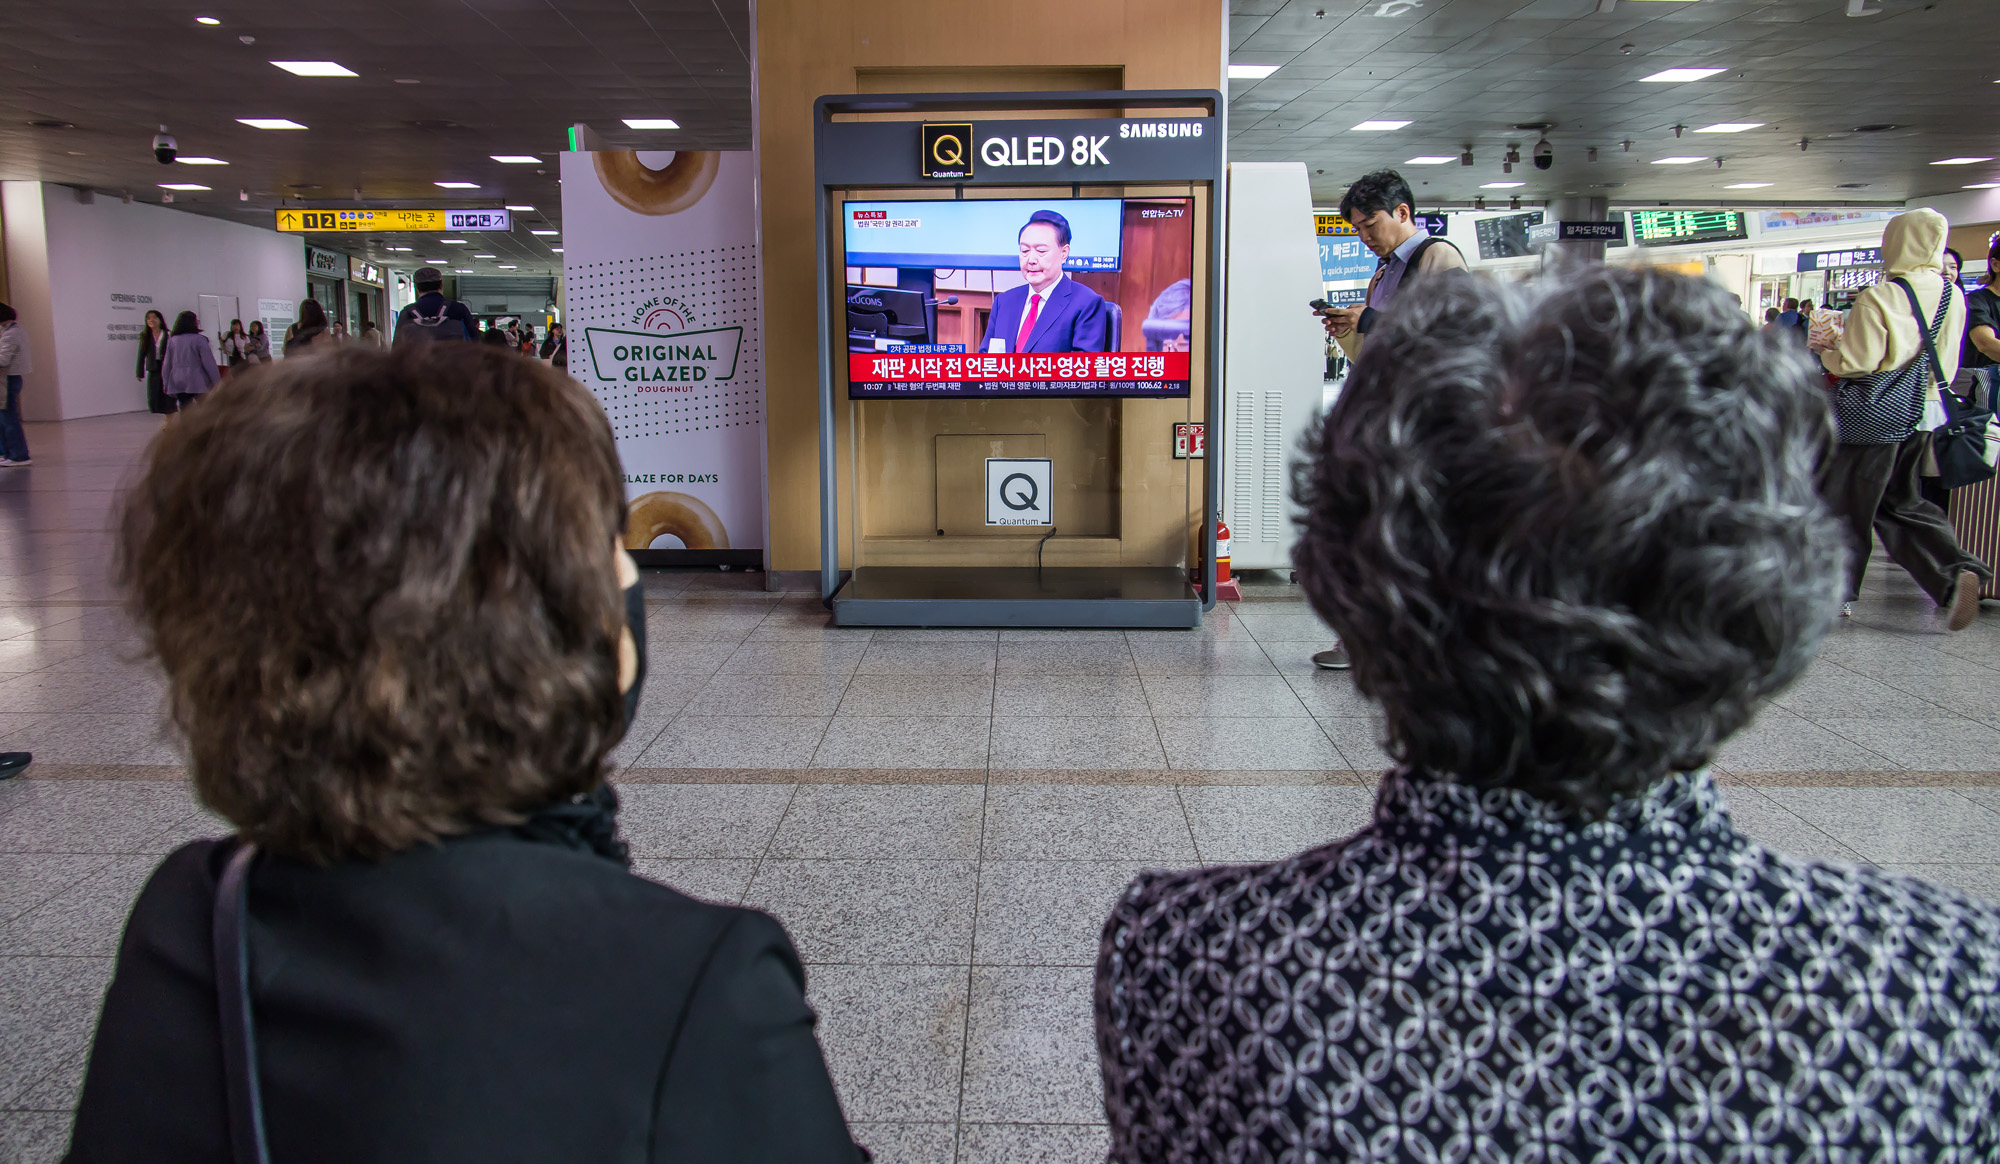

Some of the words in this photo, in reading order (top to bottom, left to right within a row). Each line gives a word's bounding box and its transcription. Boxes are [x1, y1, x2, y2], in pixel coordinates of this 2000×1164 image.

[1120, 123, 1203, 138] SAMSUNG
[981, 136, 1065, 167] QLED
[1071, 135, 1111, 165] 8K
[398, 212, 423, 222] 나가는
[427, 212, 435, 222] 곳
[1141, 209, 1184, 218] 연합뉴스TV
[324, 215, 333, 227] 2
[857, 220, 870, 228] 법원
[1566, 225, 1616, 235] 열차도착안내
[1332, 241, 1360, 261] 빠르고
[1327, 266, 1344, 277] quick
[111, 293, 136, 303] OPENING
[136, 295, 153, 303] SOON
[851, 296, 883, 306] LUCOMS
[631, 297, 660, 325] HOME
[663, 296, 679, 307] OF
[678, 302, 697, 324] THE
[613, 345, 718, 361] ORIGINAL
[890, 345, 902, 353] 2차
[903, 345, 917, 353] 공판
[917, 345, 932, 353] 법정
[933, 345, 947, 353] 내부
[948, 345, 963, 353] 공개
[872, 357, 906, 378] 재판
[908, 357, 942, 378] 시작
[945, 357, 962, 378] 전
[965, 357, 1015, 378] 언론사
[1018, 356, 1091, 378] 사진·영상
[1093, 356, 1127, 378] 촬영
[1131, 355, 1165, 378] 진행
[624, 366, 707, 382] GLAZED
[863, 383, 883, 391] 10:07
[947, 382, 962, 391] 재판
[984, 381, 998, 390] 법원
[1017, 381, 1031, 390] 영문
[1137, 381, 1162, 389] 1006.62
[660, 474, 684, 483] FOR
[688, 474, 719, 483] DAYS
[1000, 472, 1040, 511] Q
[1000, 517, 1039, 525] Quantum
